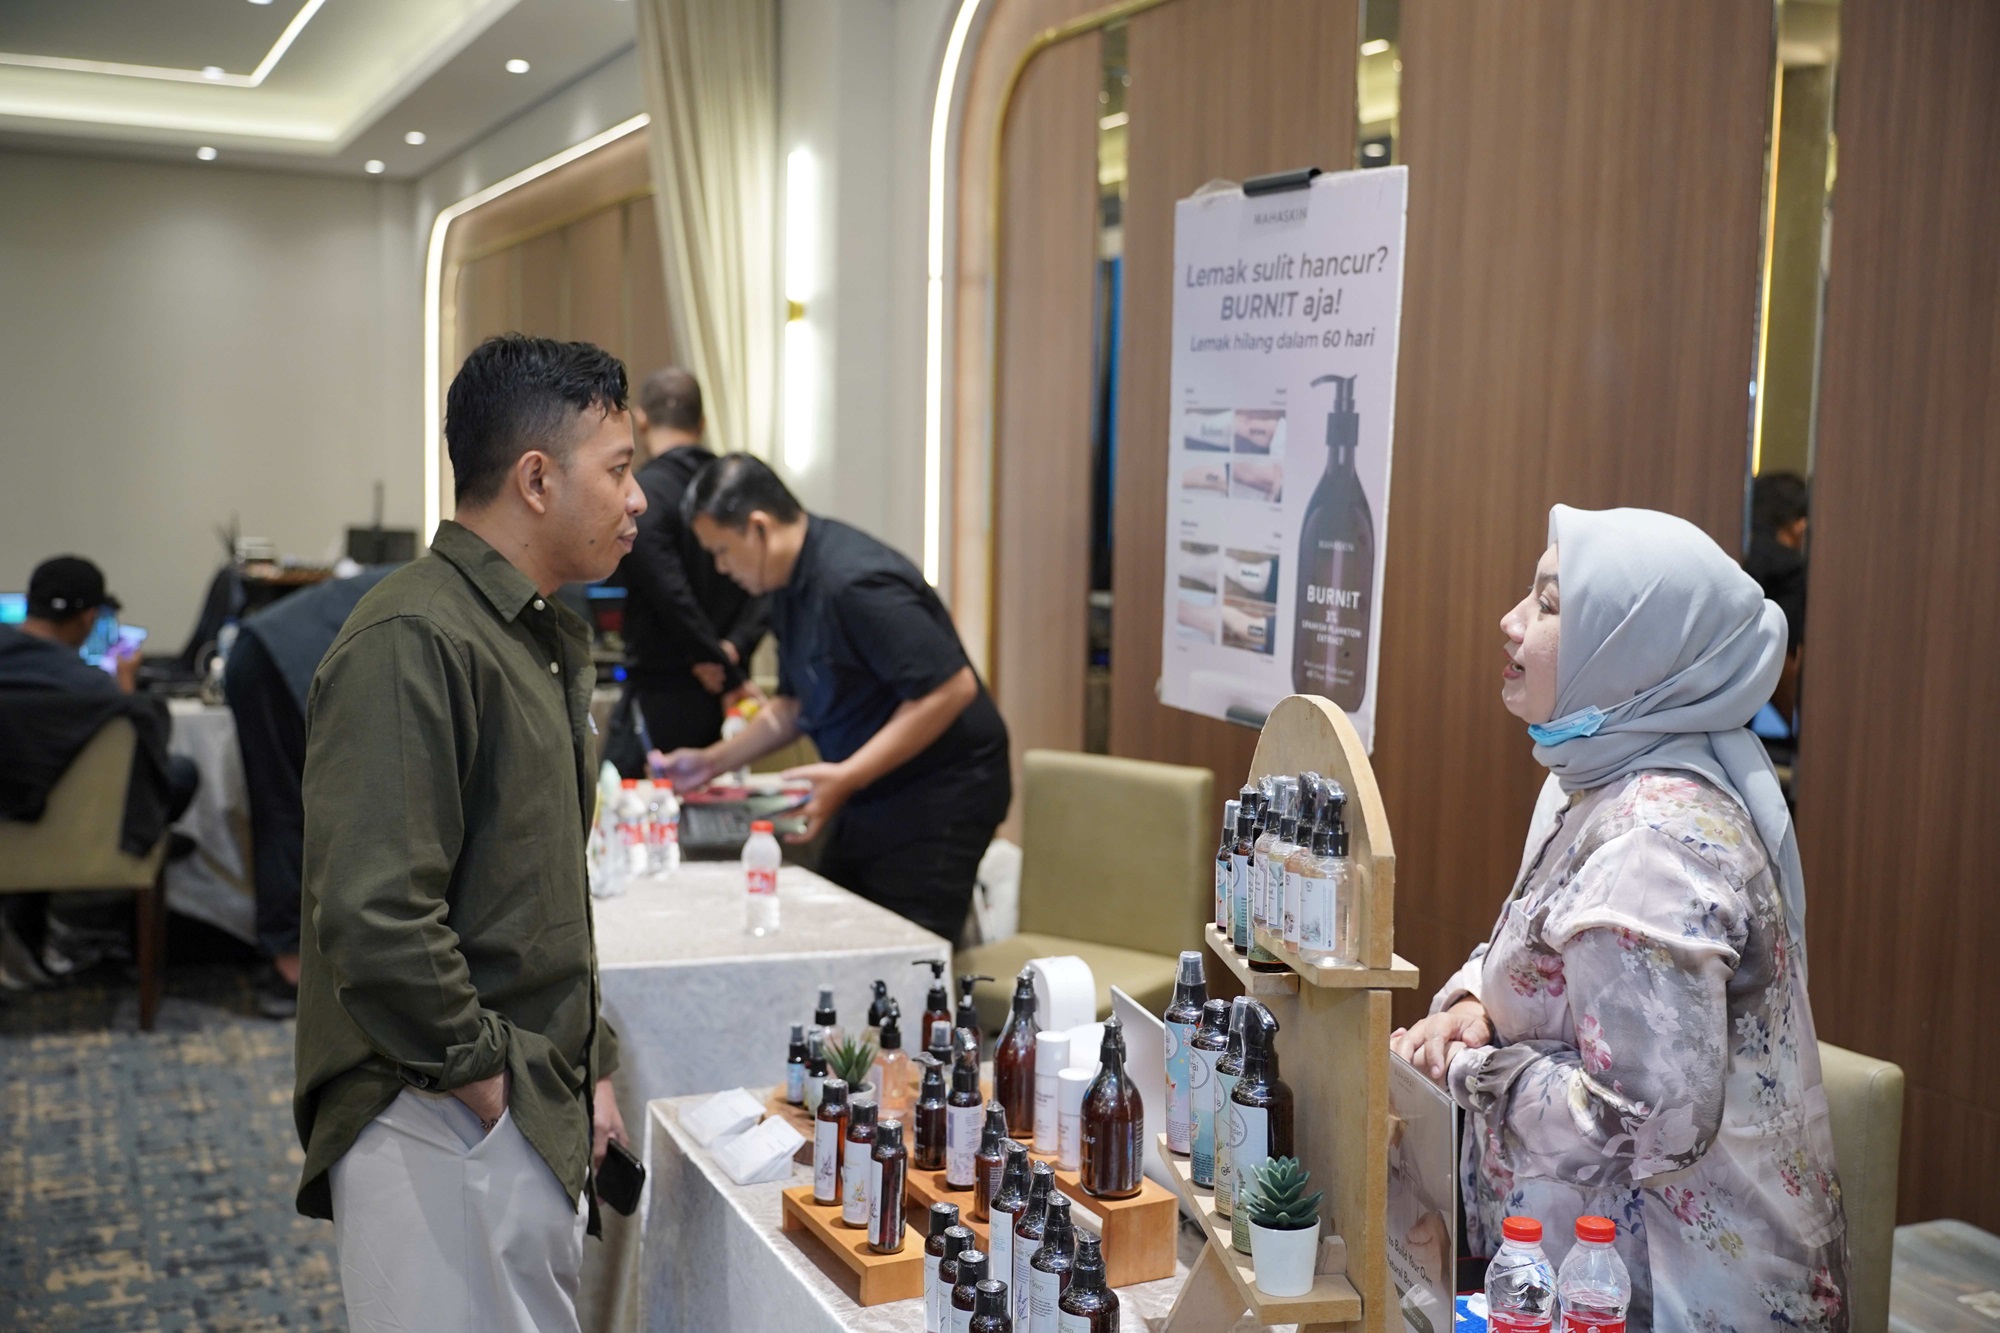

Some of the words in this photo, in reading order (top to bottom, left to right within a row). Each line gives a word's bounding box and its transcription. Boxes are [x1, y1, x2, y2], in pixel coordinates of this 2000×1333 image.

[1185, 258, 1247, 289] Lemak
[1252, 252, 1294, 283] sulit
[1300, 245, 1389, 279] hancur?
[1221, 291, 1299, 321] BURN!T
[1303, 288, 1343, 322] aja!
[1190, 333, 1231, 352] Lemak
[1233, 332, 1273, 354] hilang
[1276, 331, 1318, 350] dalam
[1322, 329, 1341, 348] 60
[1345, 327, 1376, 347] hari
[1306, 584, 1361, 610] BURN!T
[1302, 619, 1327, 633] SPANISH
[1327, 623, 1362, 639] PLANKTON
[1316, 634, 1344, 647] EXTRACT
[1394, 1238, 1408, 1261] Build
[1408, 1251, 1420, 1273] Your
[1420, 1266, 1433, 1288] Own
